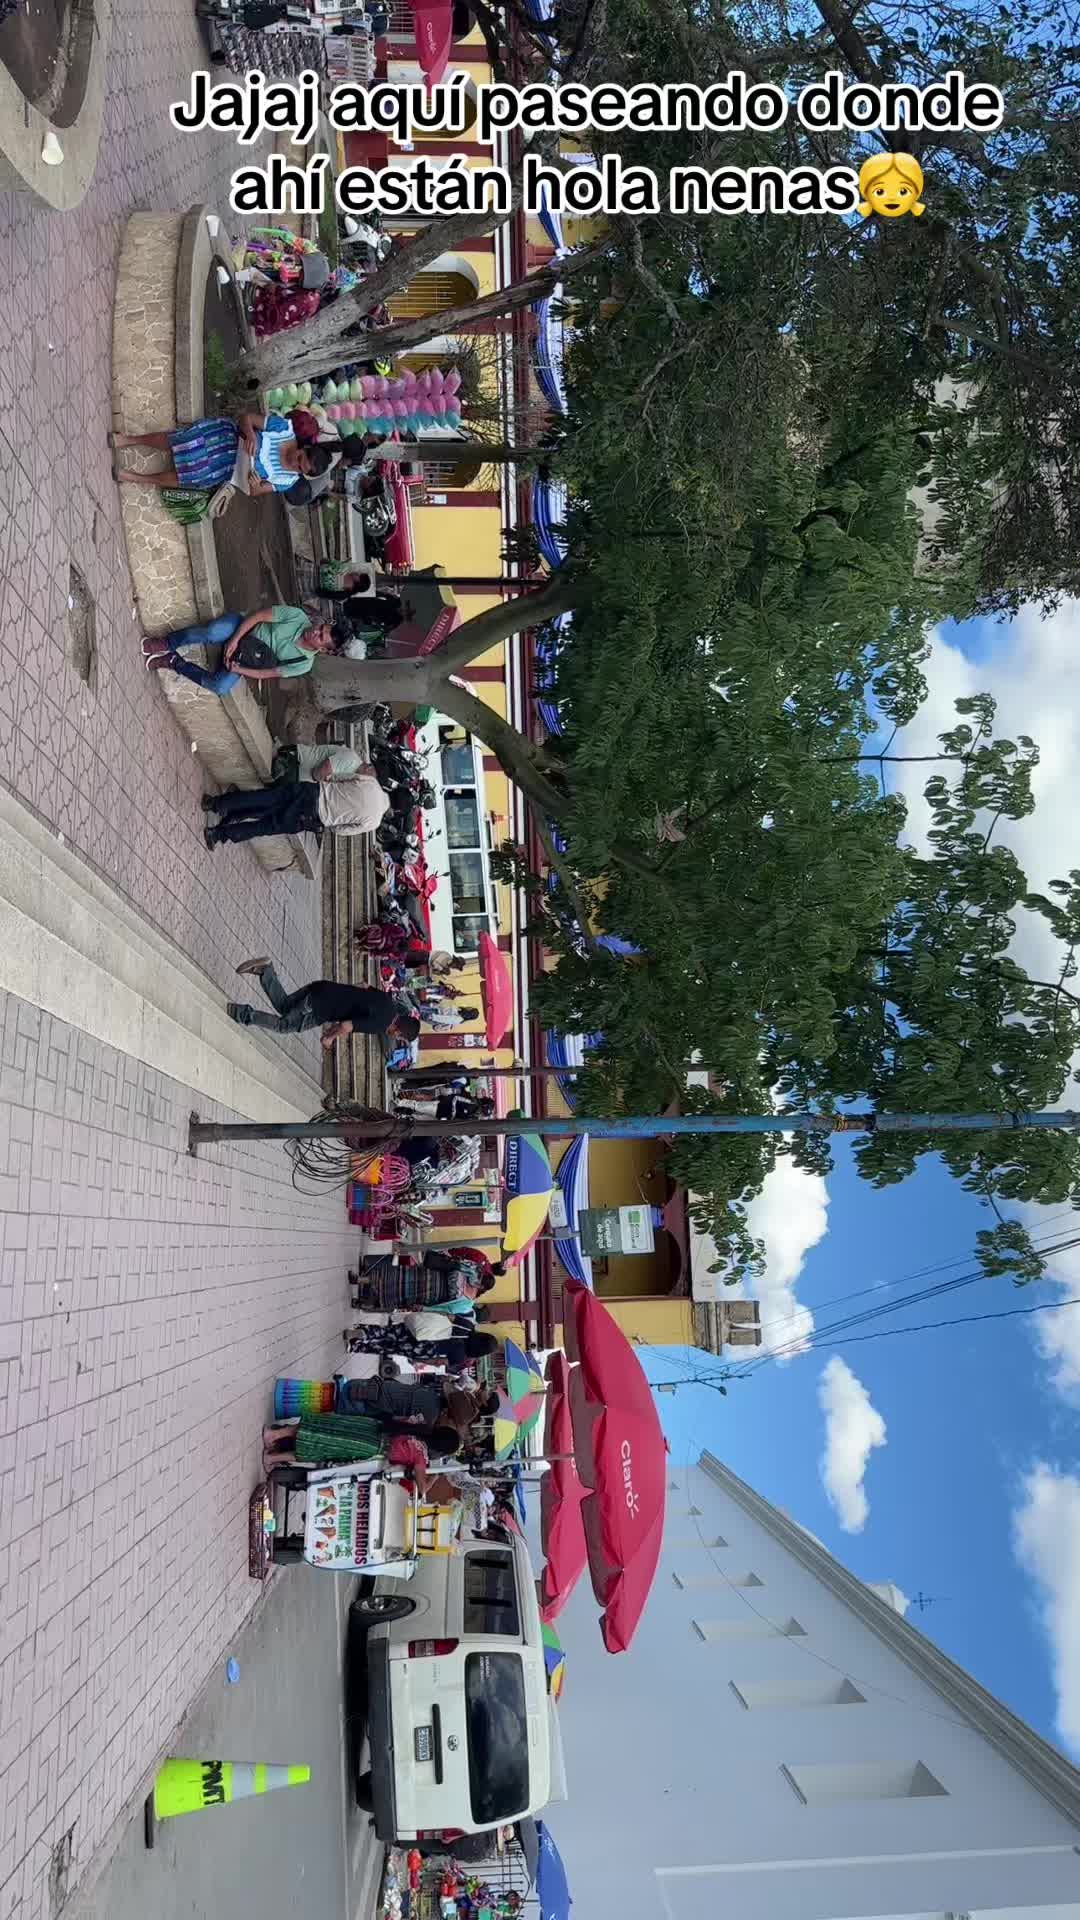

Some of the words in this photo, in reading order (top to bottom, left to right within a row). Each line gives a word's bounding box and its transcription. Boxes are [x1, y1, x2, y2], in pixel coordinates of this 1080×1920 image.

[424, 613, 450, 654] DIRECT
[508, 1140, 518, 1189] DIRECT
[597, 1224, 604, 1232] de
[356, 1481, 370, 1509] ICOS
[621, 1440, 637, 1513] Claro
[354, 1512, 369, 1565] HELADOS
[201, 1760, 225, 1806] PMT
